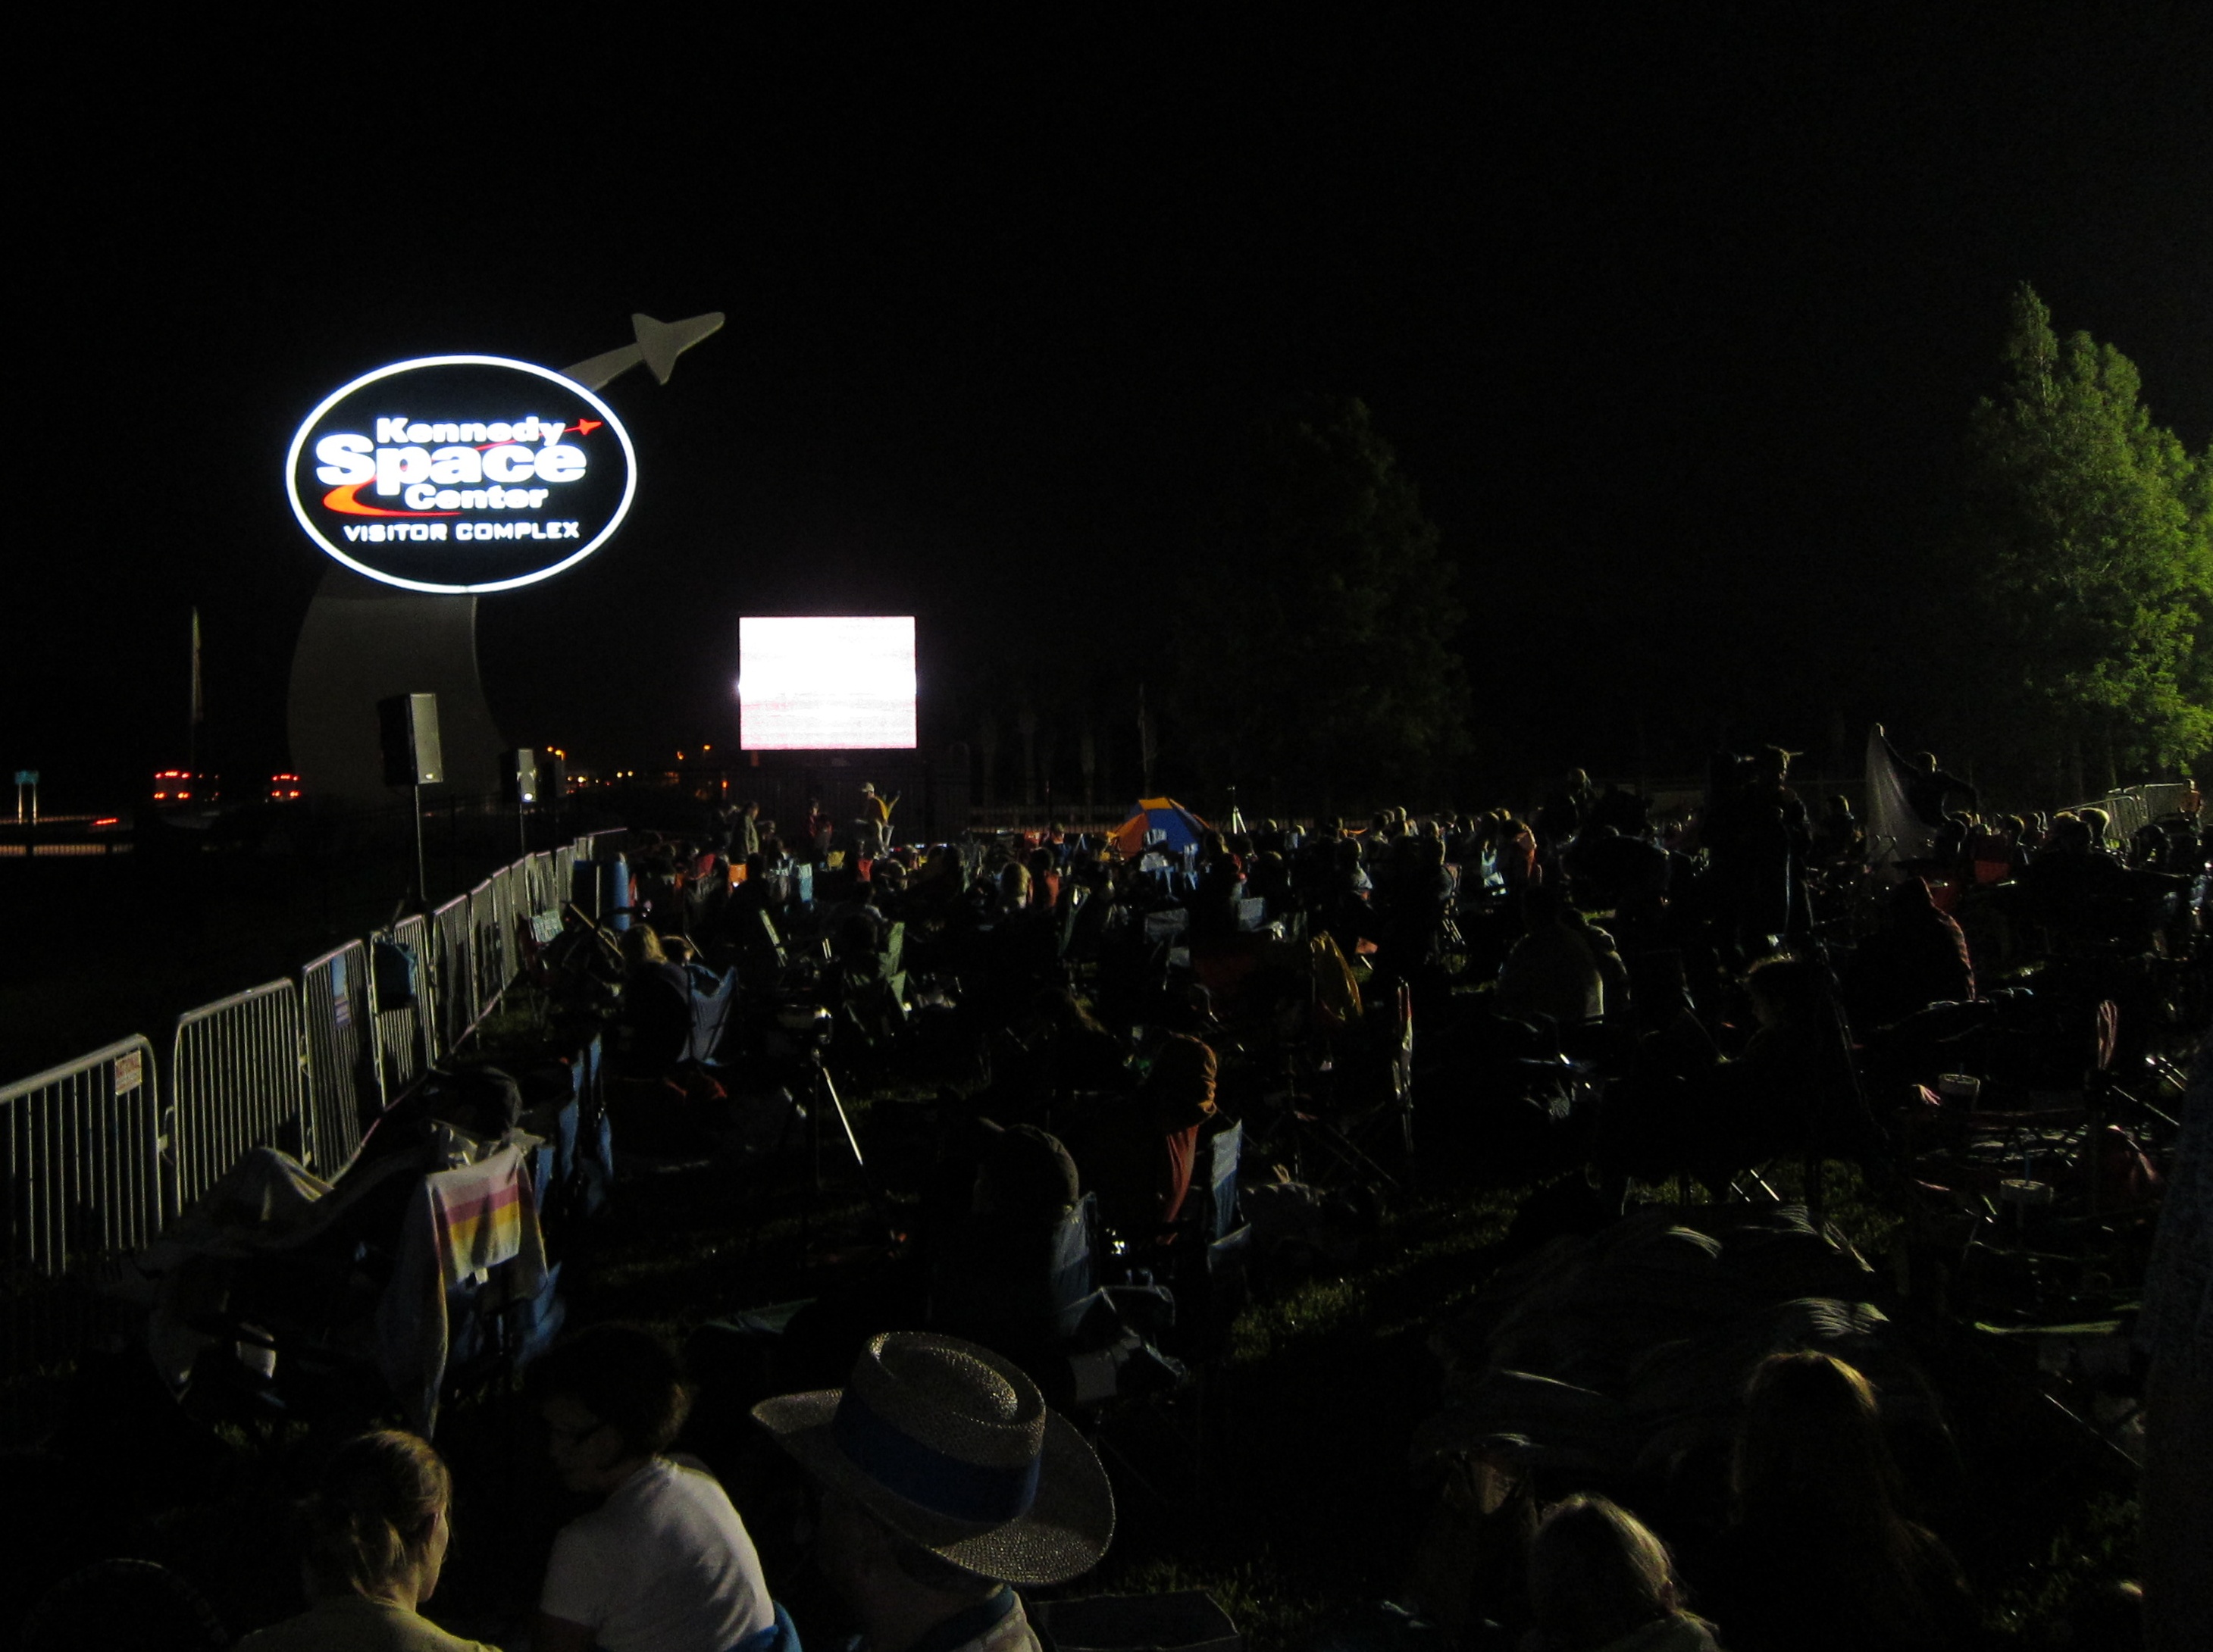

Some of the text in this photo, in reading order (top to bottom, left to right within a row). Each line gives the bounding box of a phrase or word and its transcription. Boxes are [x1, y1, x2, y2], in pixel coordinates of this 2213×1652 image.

[377, 417, 566, 446] Kennedy
[316, 433, 587, 496] Space
[404, 484, 549, 510] Center
[343, 522, 579, 542] VISITOR COMPLEX
